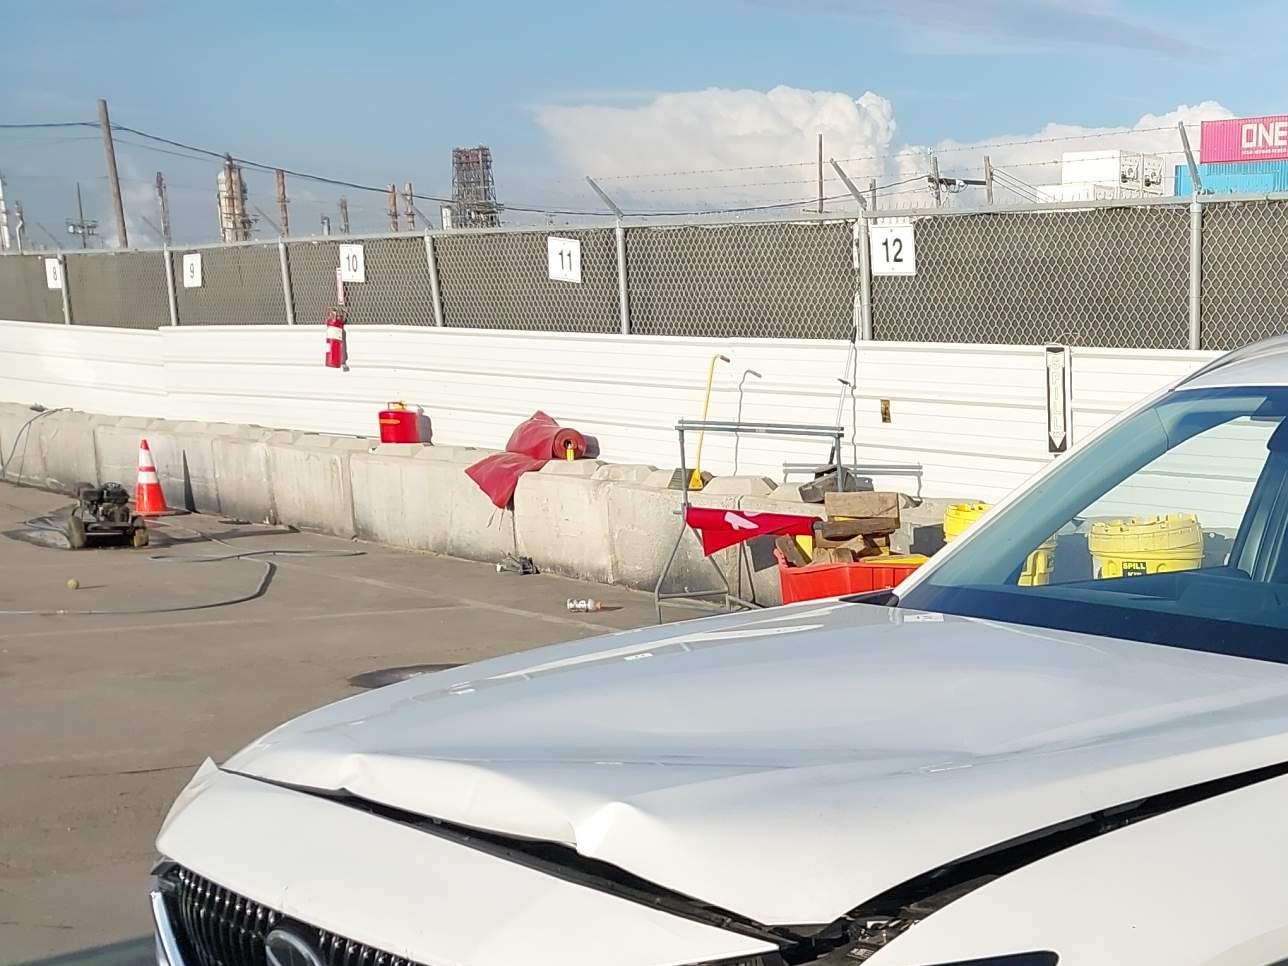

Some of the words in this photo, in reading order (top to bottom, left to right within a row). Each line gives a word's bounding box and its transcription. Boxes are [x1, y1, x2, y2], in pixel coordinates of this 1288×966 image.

[1241, 121, 1288, 149] ONE
[557, 249, 573, 271] 11
[881, 237, 904, 263] 12
[52, 266, 58, 281] 8
[188, 262, 195, 279] 9
[345, 253, 358, 274] 10
[1123, 562, 1146, 570] SPILL
